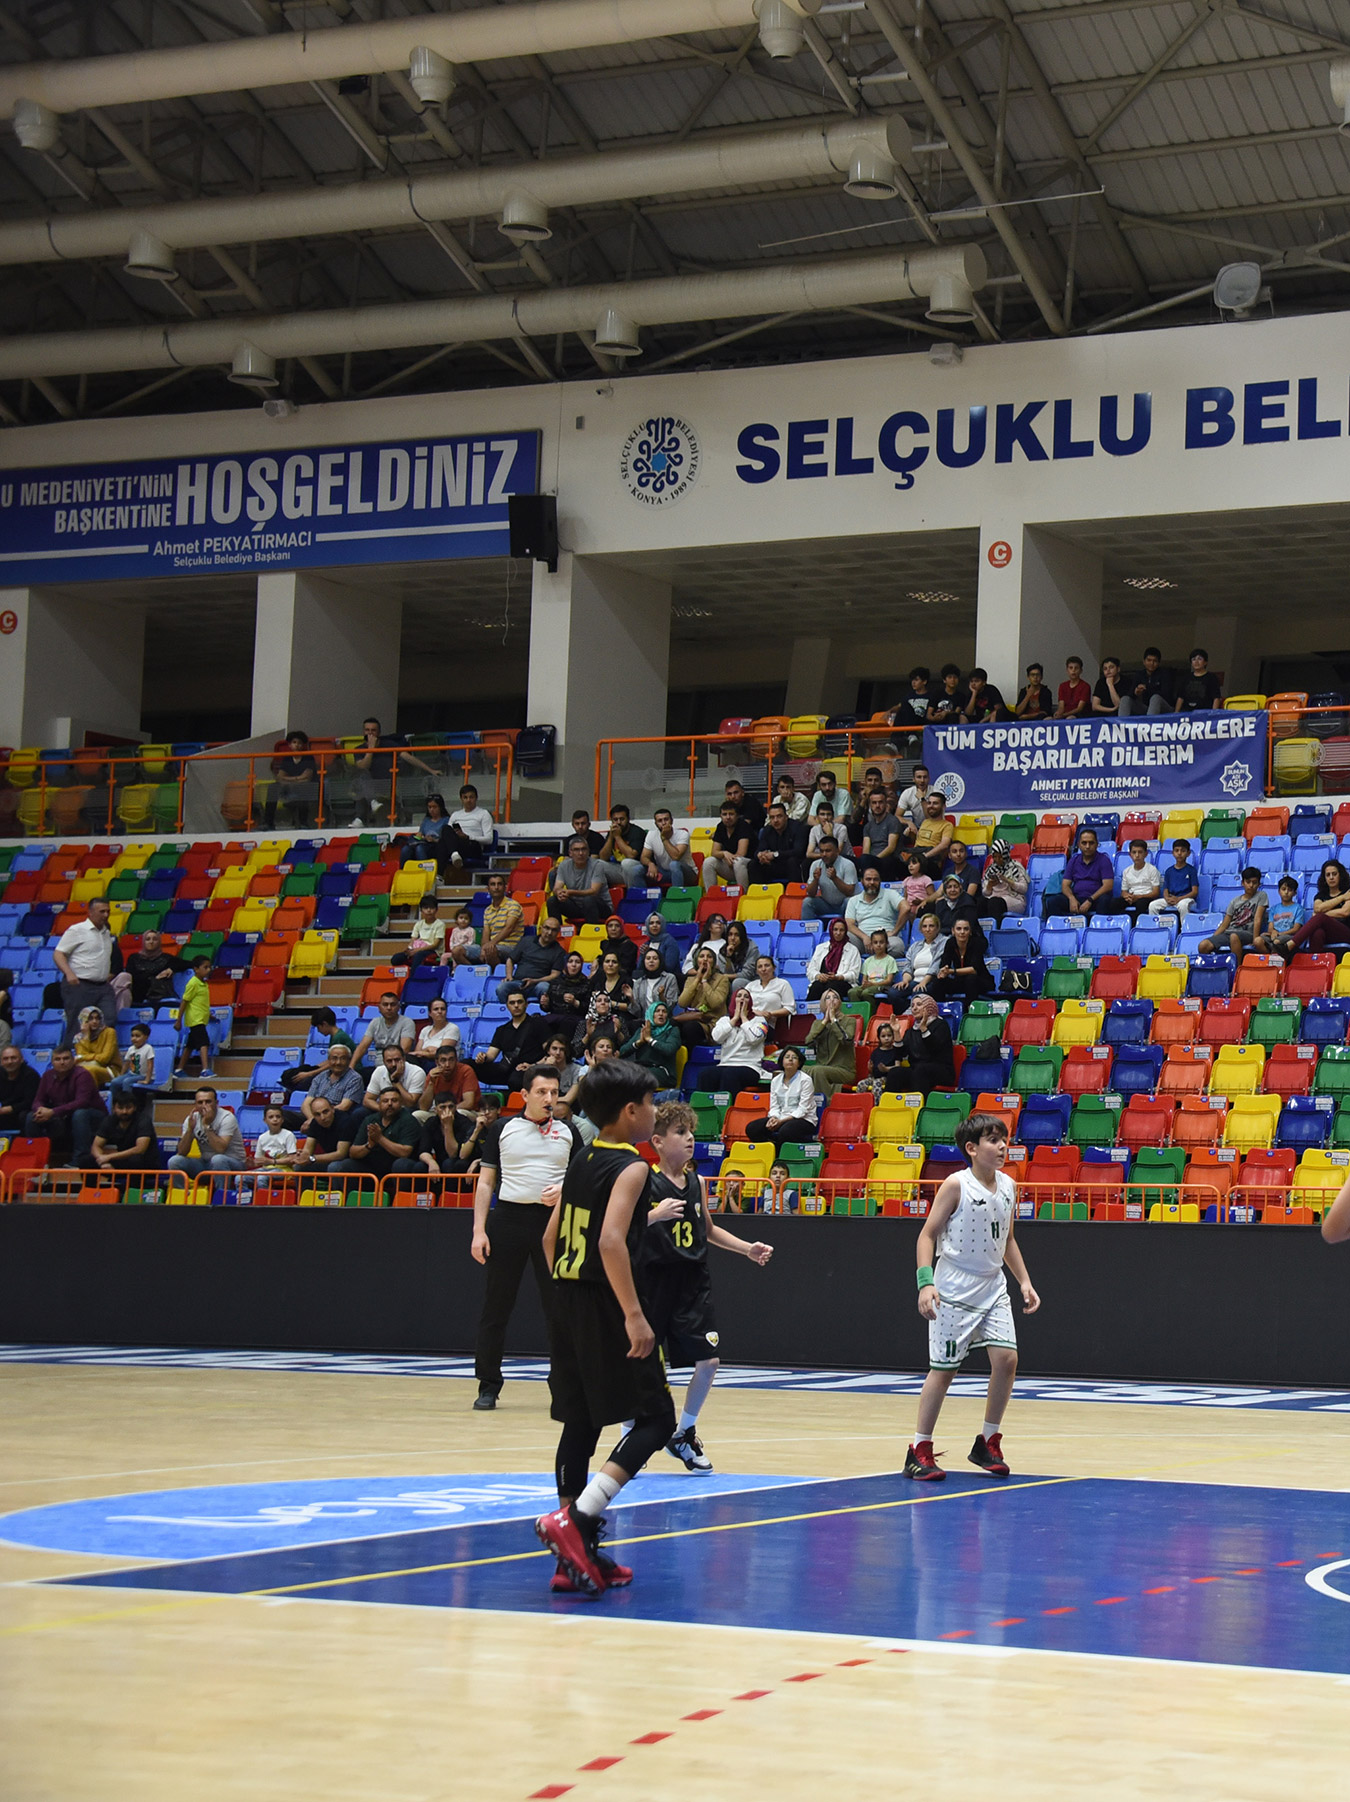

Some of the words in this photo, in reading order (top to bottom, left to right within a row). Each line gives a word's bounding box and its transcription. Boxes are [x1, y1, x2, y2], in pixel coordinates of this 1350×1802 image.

[620, 422, 647, 480] SELÇUKLU
[674, 419, 700, 482] BELEDİYESİ
[735, 391, 1152, 490] SELÇUKLU
[630, 487, 663, 505] KONYA
[670, 481, 688, 500] 1989
[153, 540, 200, 556] Ahmet
[203, 531, 312, 552] PEKYATIRMACI
[993, 544, 1008, 560] C
[173, 555, 213, 568] Selçuklu
[214, 552, 253, 566] Belediye
[254, 550, 291, 563] Başkanı
[935, 726, 976, 751] TÜM
[982, 725, 1059, 749] SPORCU
[1065, 724, 1092, 745] VE
[1097, 717, 1257, 744] ANTRENÖRLERE
[993, 747, 1105, 776] BAŞARILAR
[1031, 779, 1068, 791] AHMET
[1070, 776, 1151, 789] PEKYATIRMACI
[1040, 792, 1075, 802] SELÇUKLU
[1109, 789, 1139, 801] BAŞKANI
[1227, 779, 1245, 789] AŞK
[553, 1203, 592, 1279] 15
[672, 1221, 693, 1248] 13
